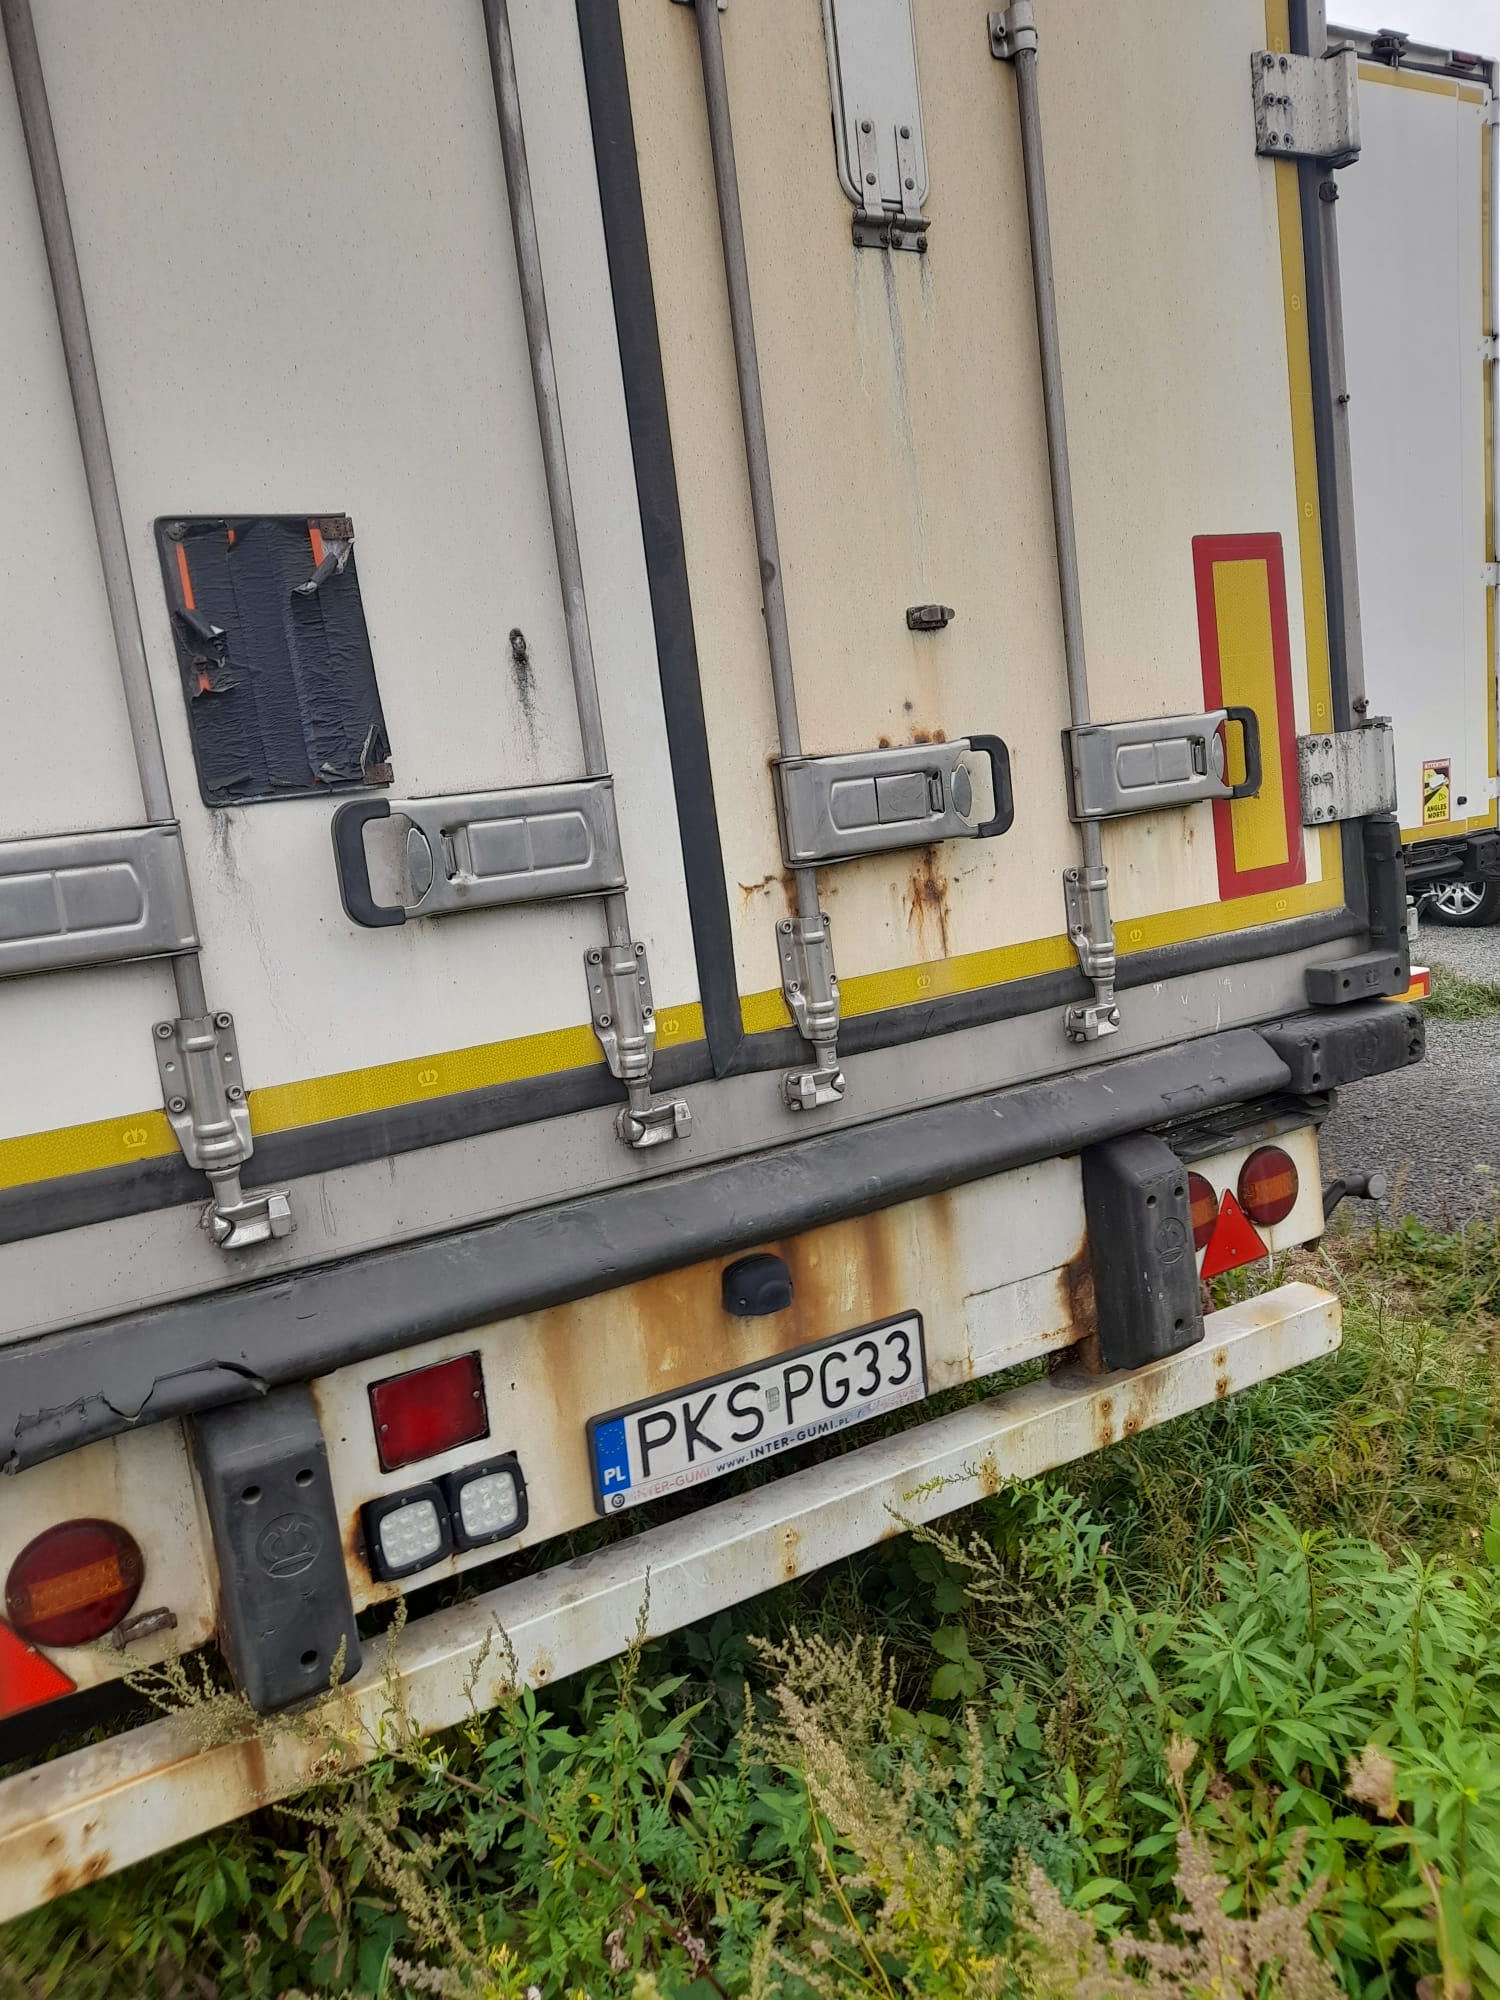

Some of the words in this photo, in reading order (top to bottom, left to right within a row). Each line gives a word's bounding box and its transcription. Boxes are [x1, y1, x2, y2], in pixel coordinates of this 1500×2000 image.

[1426, 803, 1447, 812] ANGLES
[1427, 811, 1446, 819] MORTS
[637, 1382, 763, 1477] PKS
[783, 1330, 912, 1424] PG33
[604, 1467, 626, 1486] PL
